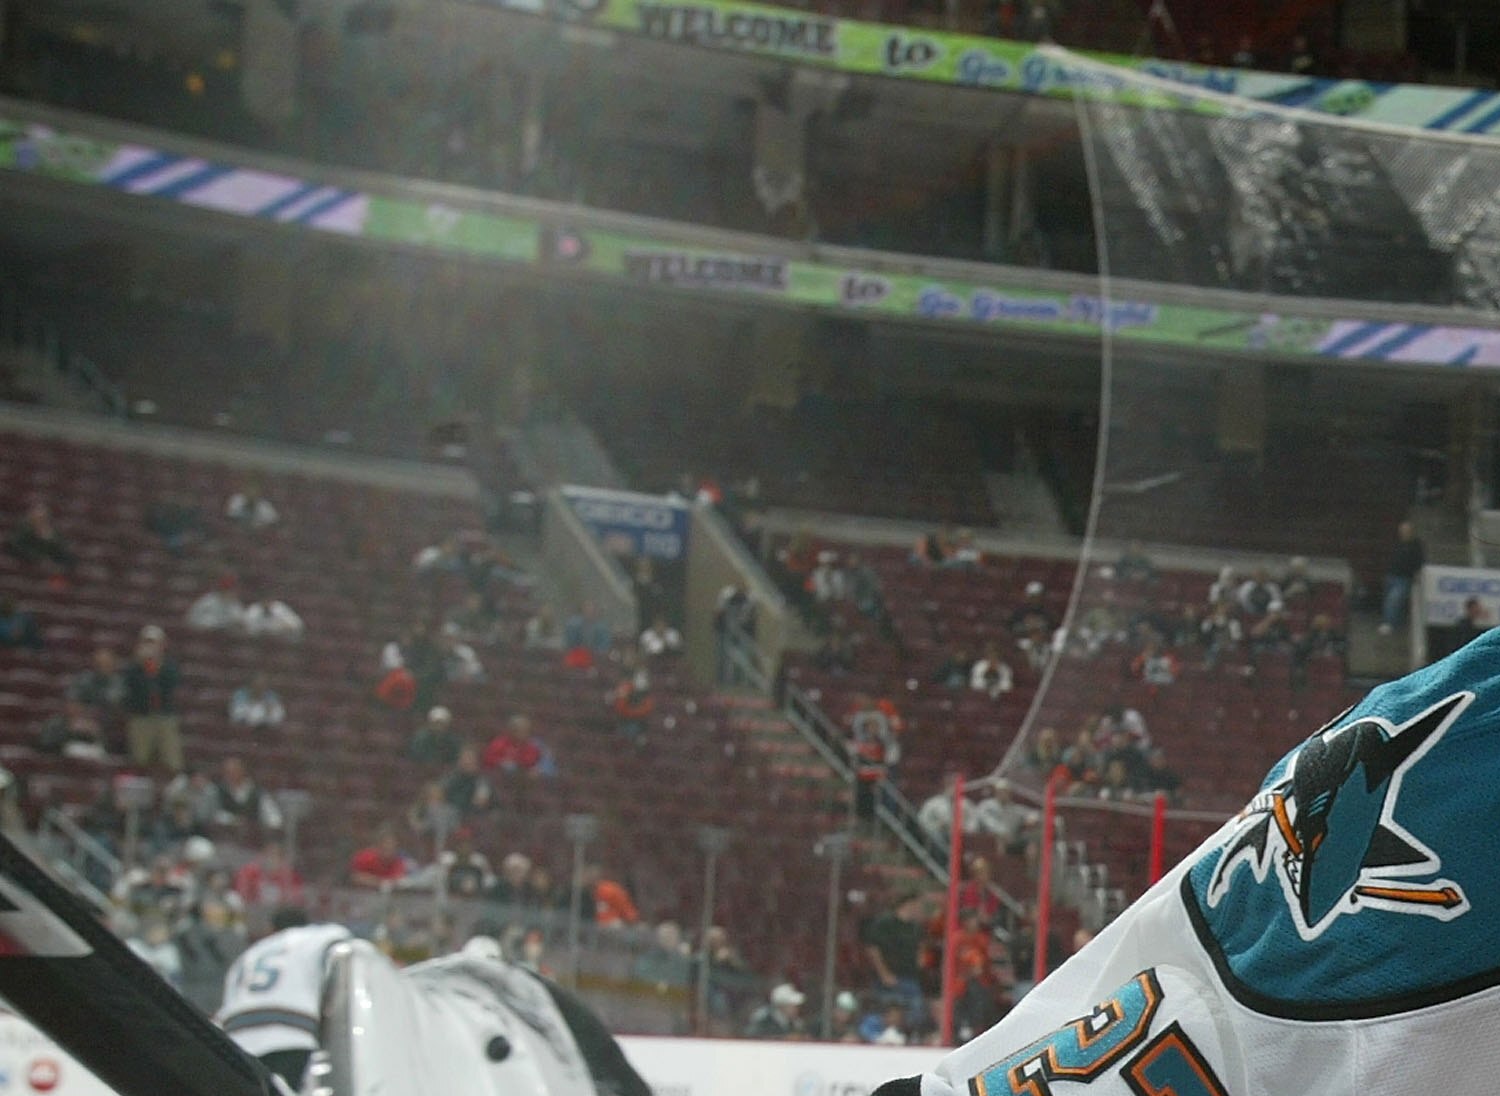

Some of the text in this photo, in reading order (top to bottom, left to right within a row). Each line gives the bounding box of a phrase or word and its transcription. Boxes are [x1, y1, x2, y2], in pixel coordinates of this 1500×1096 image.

[640, 5, 835, 52] WELCOME
[887, 35, 934, 68] to
[844, 274, 888, 302] to
